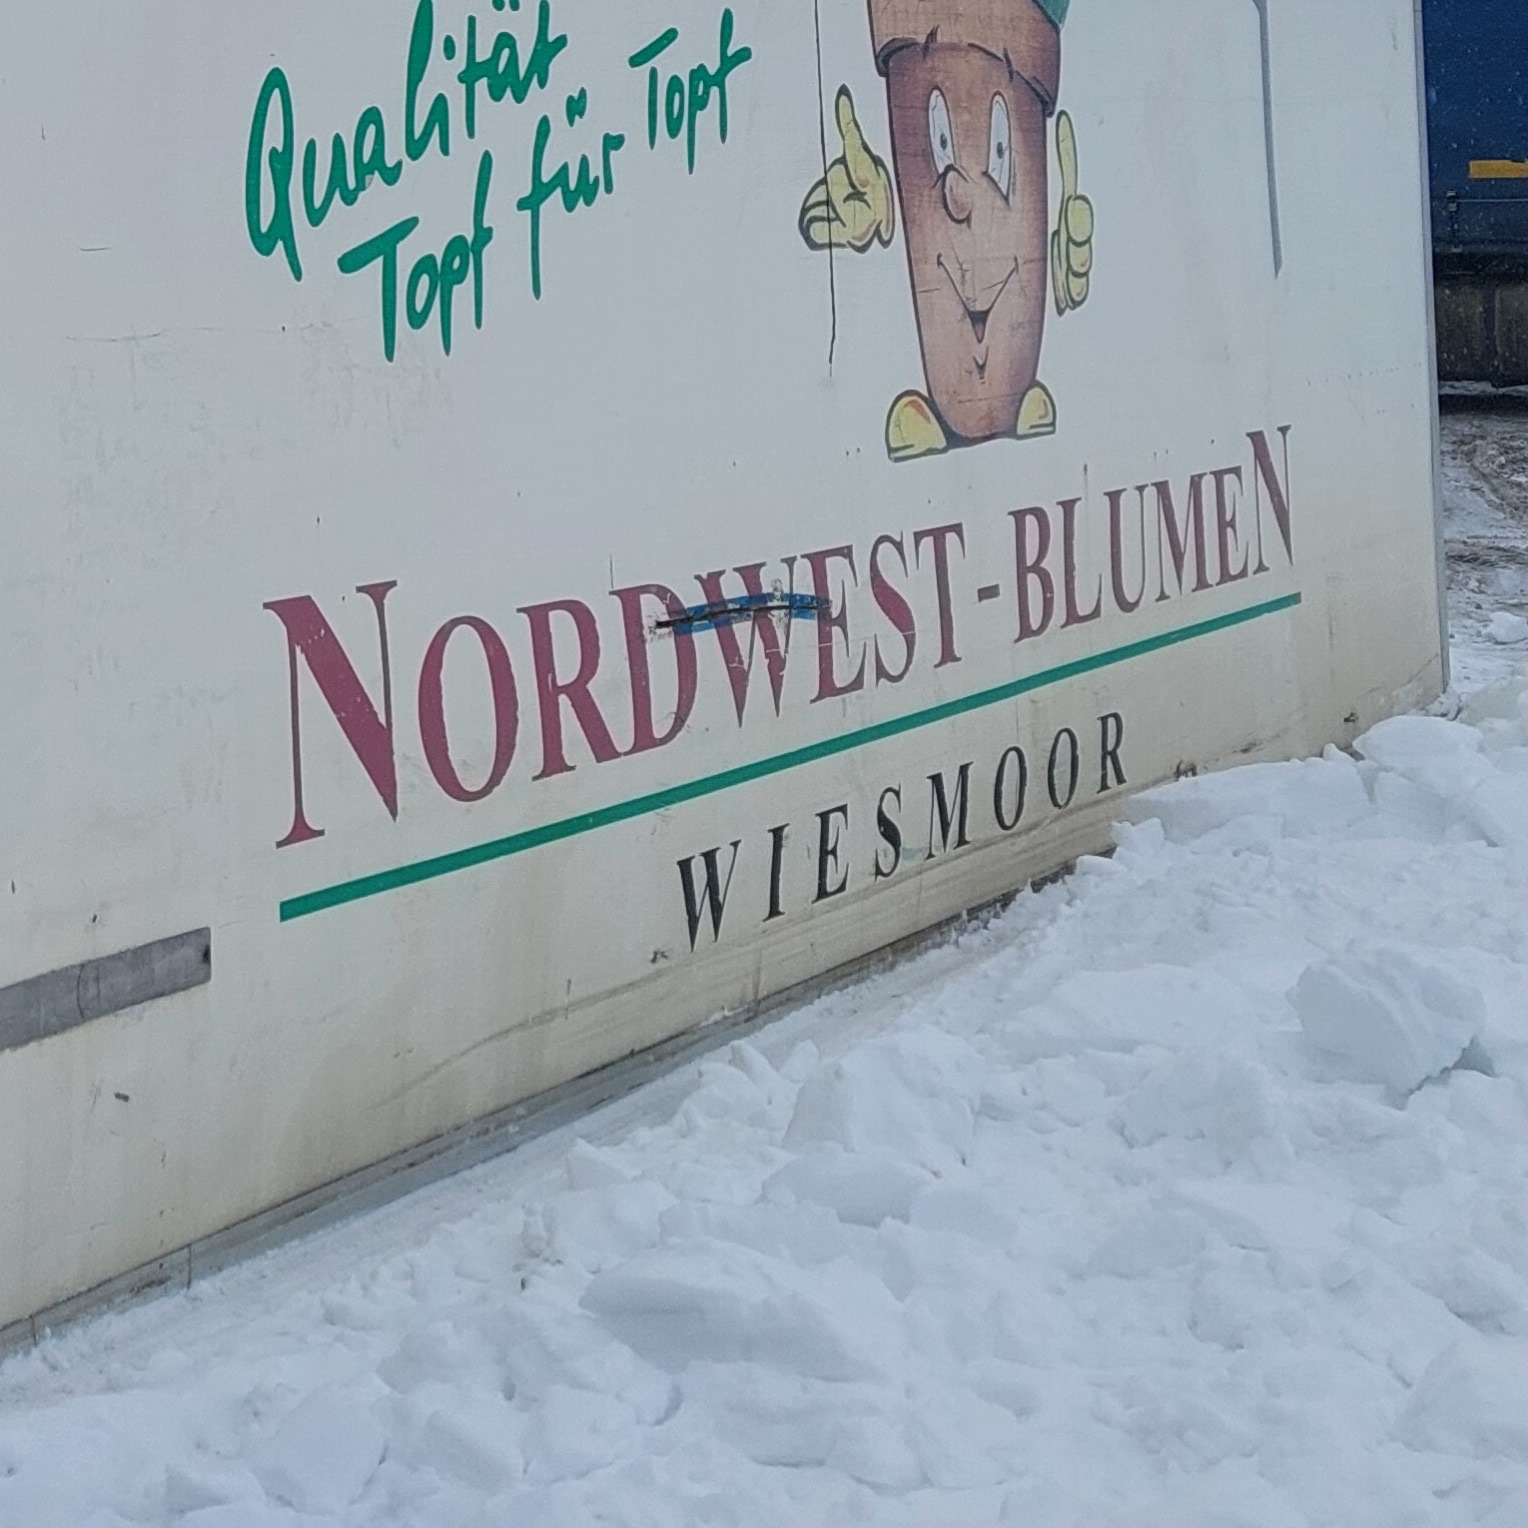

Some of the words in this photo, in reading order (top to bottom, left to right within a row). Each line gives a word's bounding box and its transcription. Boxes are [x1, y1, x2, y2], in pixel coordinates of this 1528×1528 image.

[337, 149, 494, 363] Topf
[516, 86, 626, 301] für
[627, 7, 753, 175] Topf
[263, 424, 1295, 848] NORDWEST-BLUMEN
[677, 710, 1127, 953] WIESMOOR
